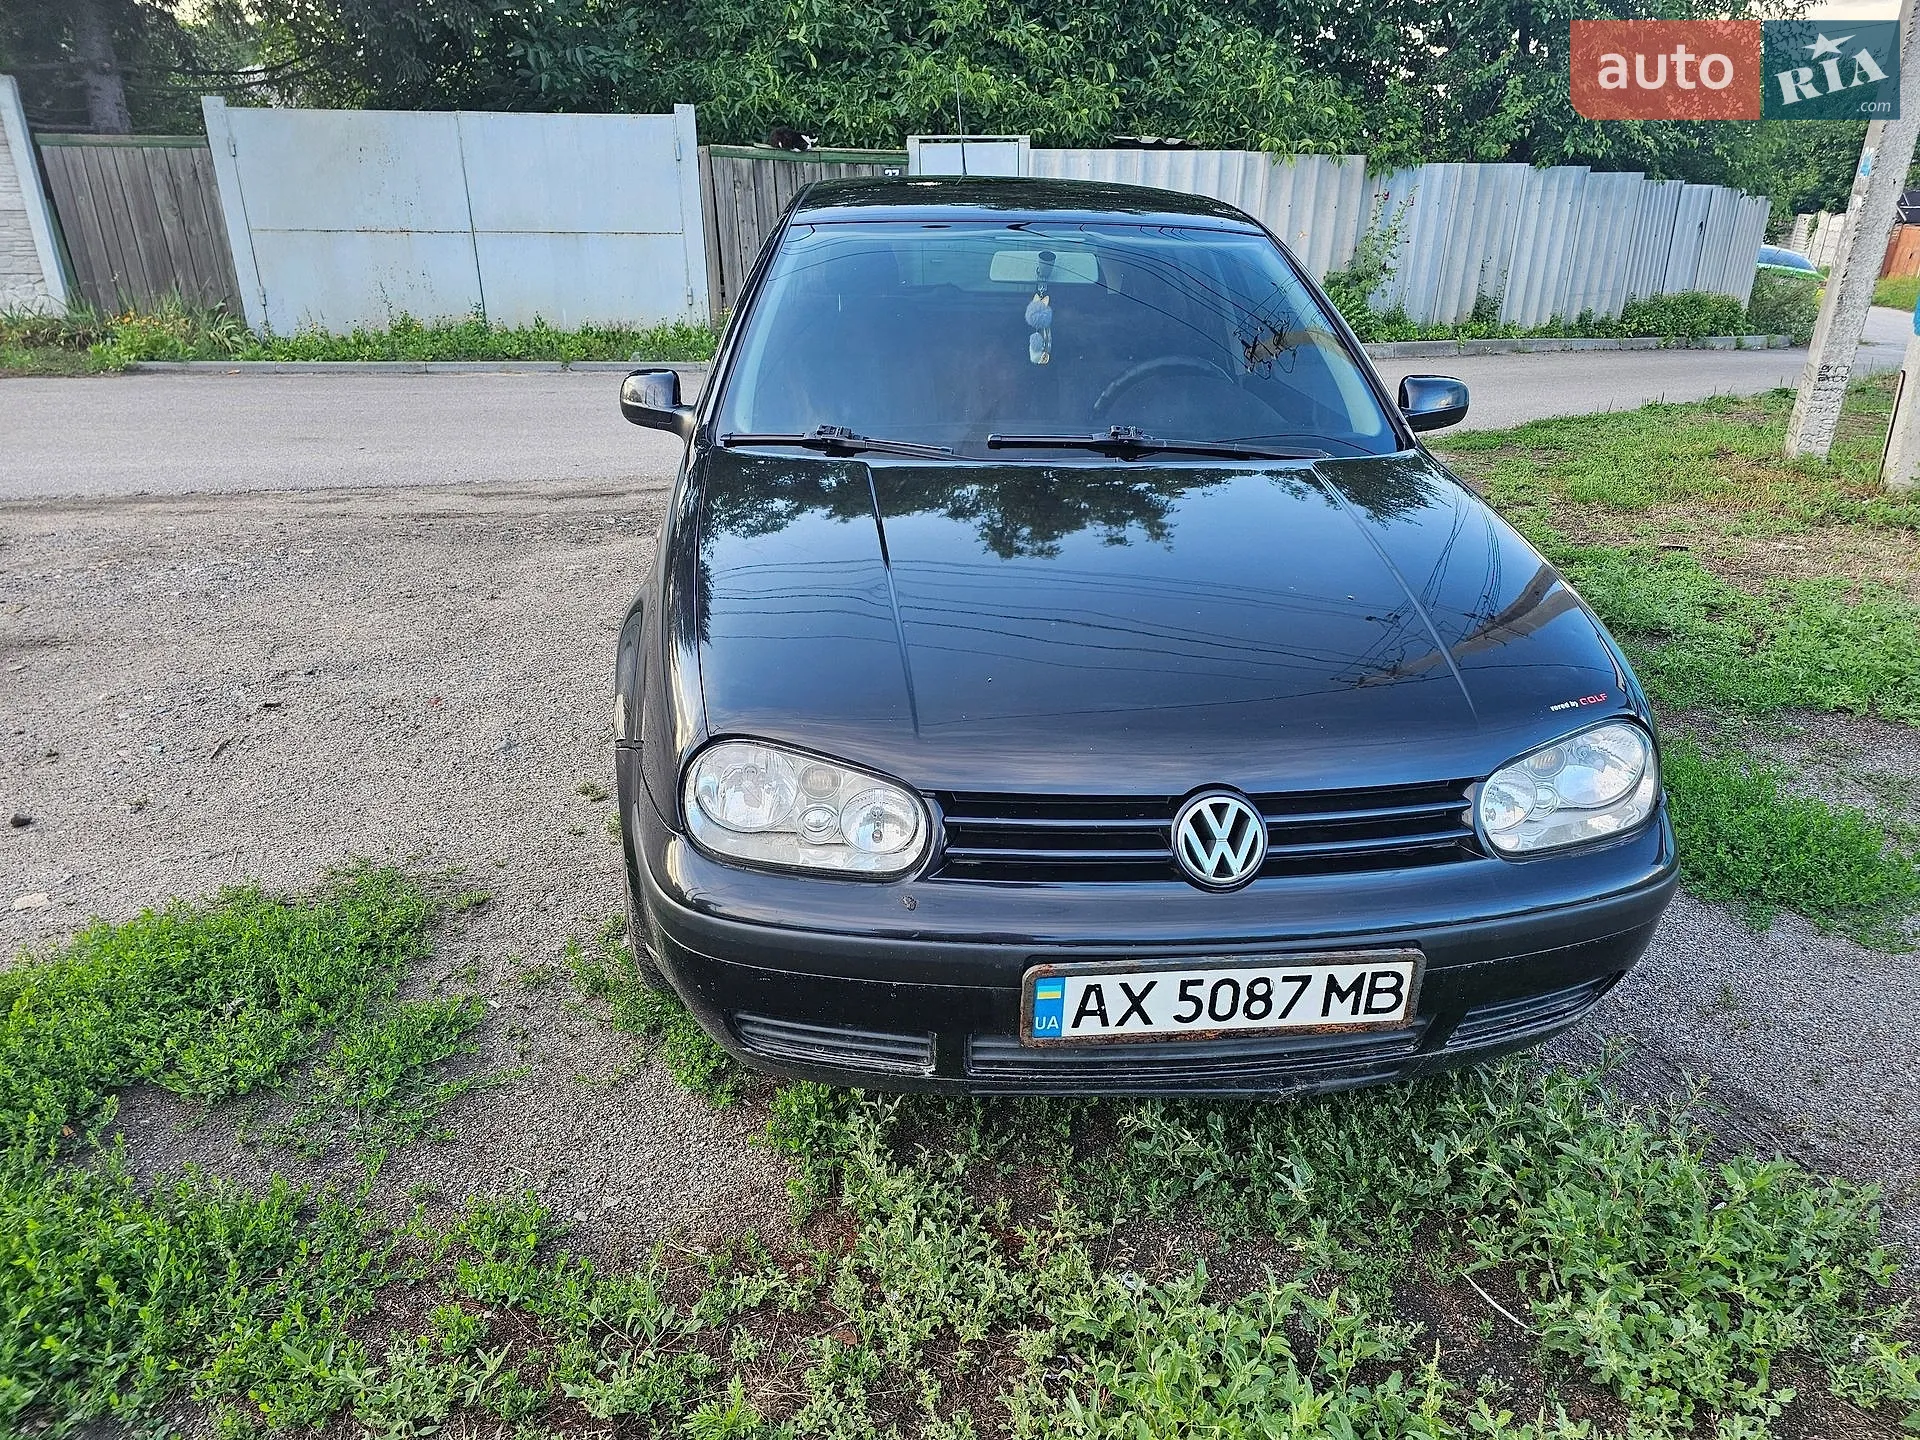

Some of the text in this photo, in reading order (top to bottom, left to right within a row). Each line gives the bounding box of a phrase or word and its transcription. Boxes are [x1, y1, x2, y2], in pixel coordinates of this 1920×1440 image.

[1071, 970, 1404, 1029] AX 5087 MB
[1035, 1016, 1059, 1031] UA
